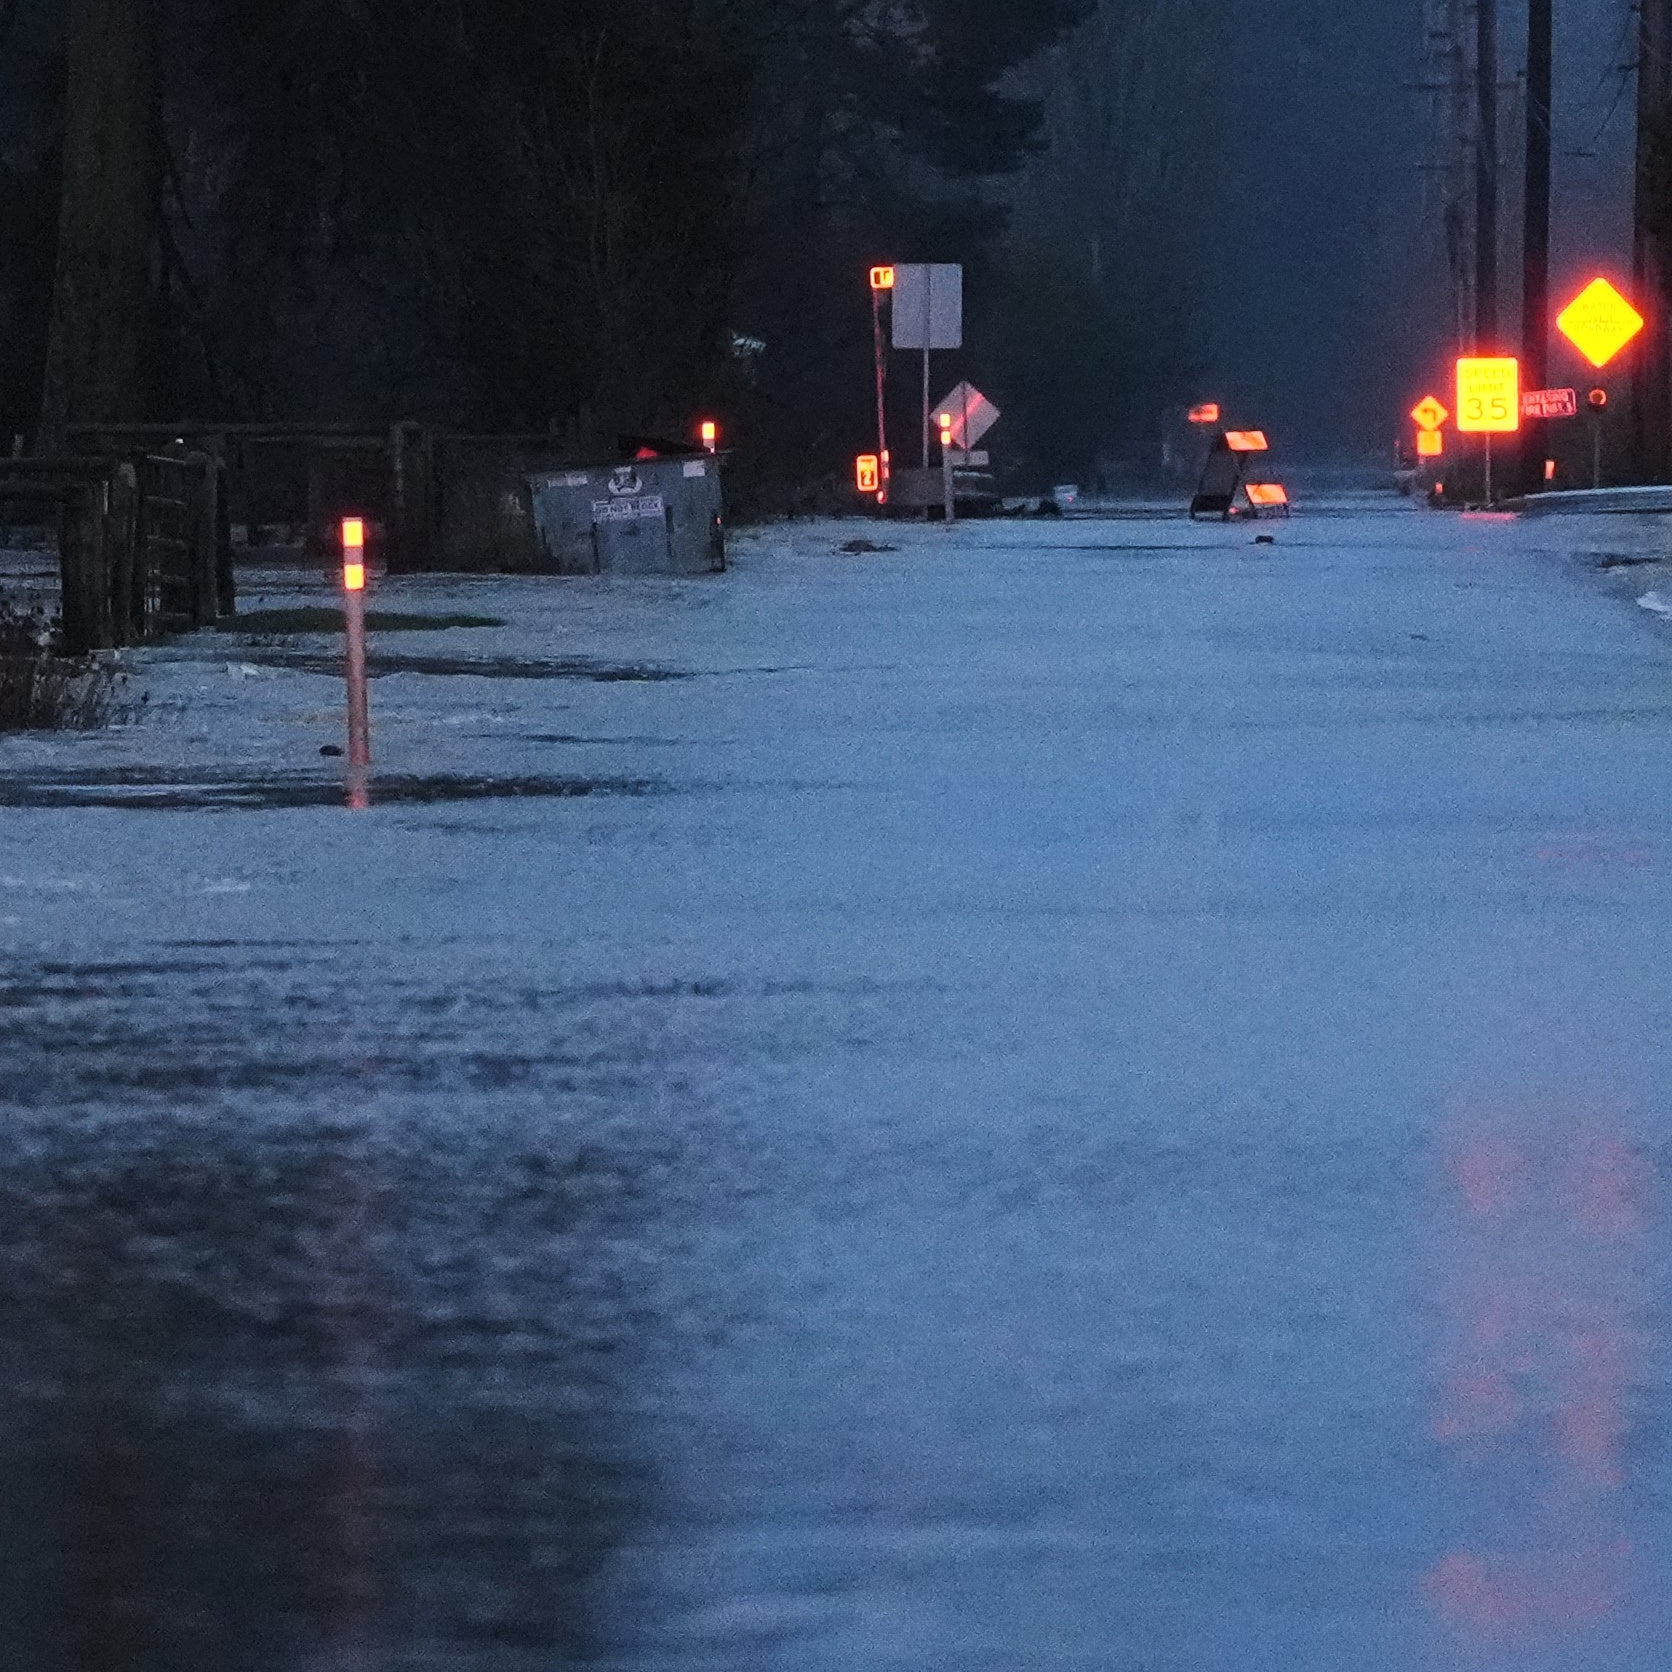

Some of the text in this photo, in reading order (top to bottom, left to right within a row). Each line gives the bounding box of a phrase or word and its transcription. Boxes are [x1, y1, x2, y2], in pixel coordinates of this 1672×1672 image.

[1464, 367, 1511, 378] SPEED
[1469, 382, 1504, 393] LIMIT
[1466, 397, 1508, 420] 35
